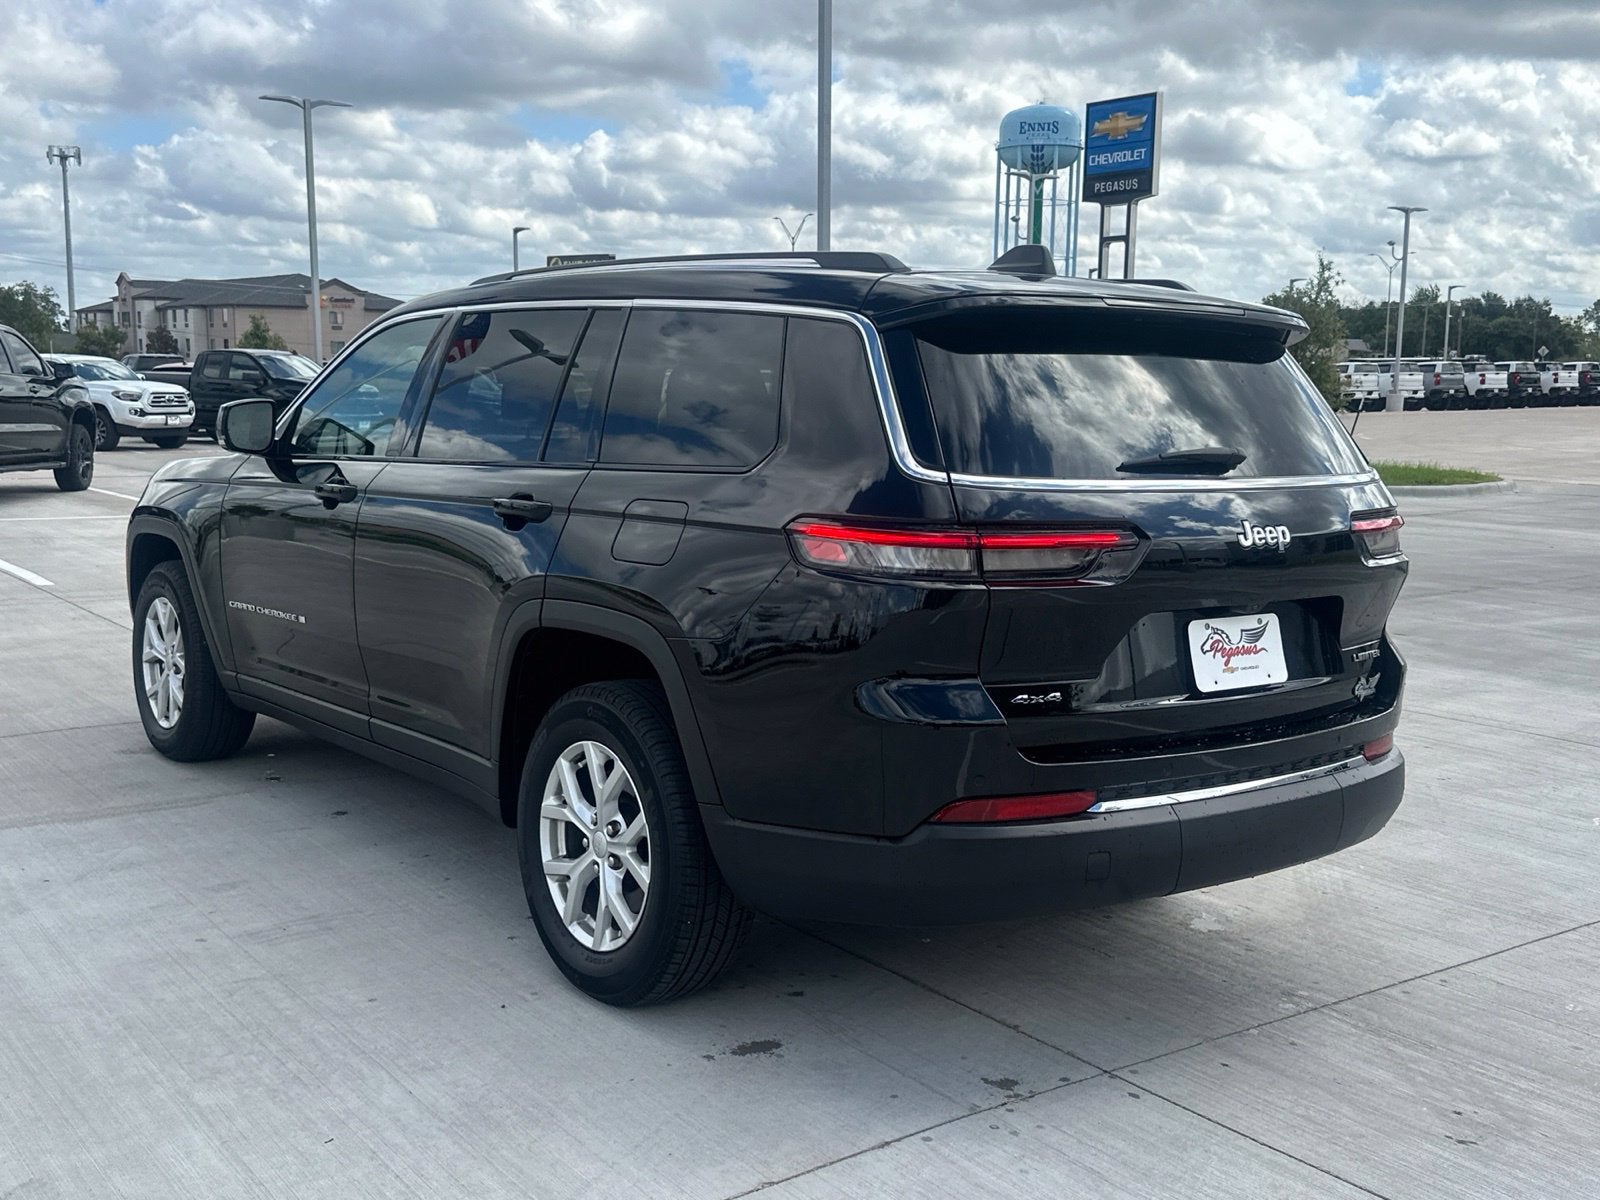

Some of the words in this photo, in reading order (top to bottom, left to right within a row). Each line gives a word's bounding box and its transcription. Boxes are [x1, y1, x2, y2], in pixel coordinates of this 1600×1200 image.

[1019, 121, 1059, 134] ENNIS
[1089, 149, 1146, 166] CHEVROLET
[1094, 179, 1138, 193] PEGASUS
[1237, 520, 1291, 551] Jeep
[229, 601, 255, 612] GRAND
[256, 606, 297, 622] CHEROKEE
[1210, 639, 1268, 667] Pegasus
